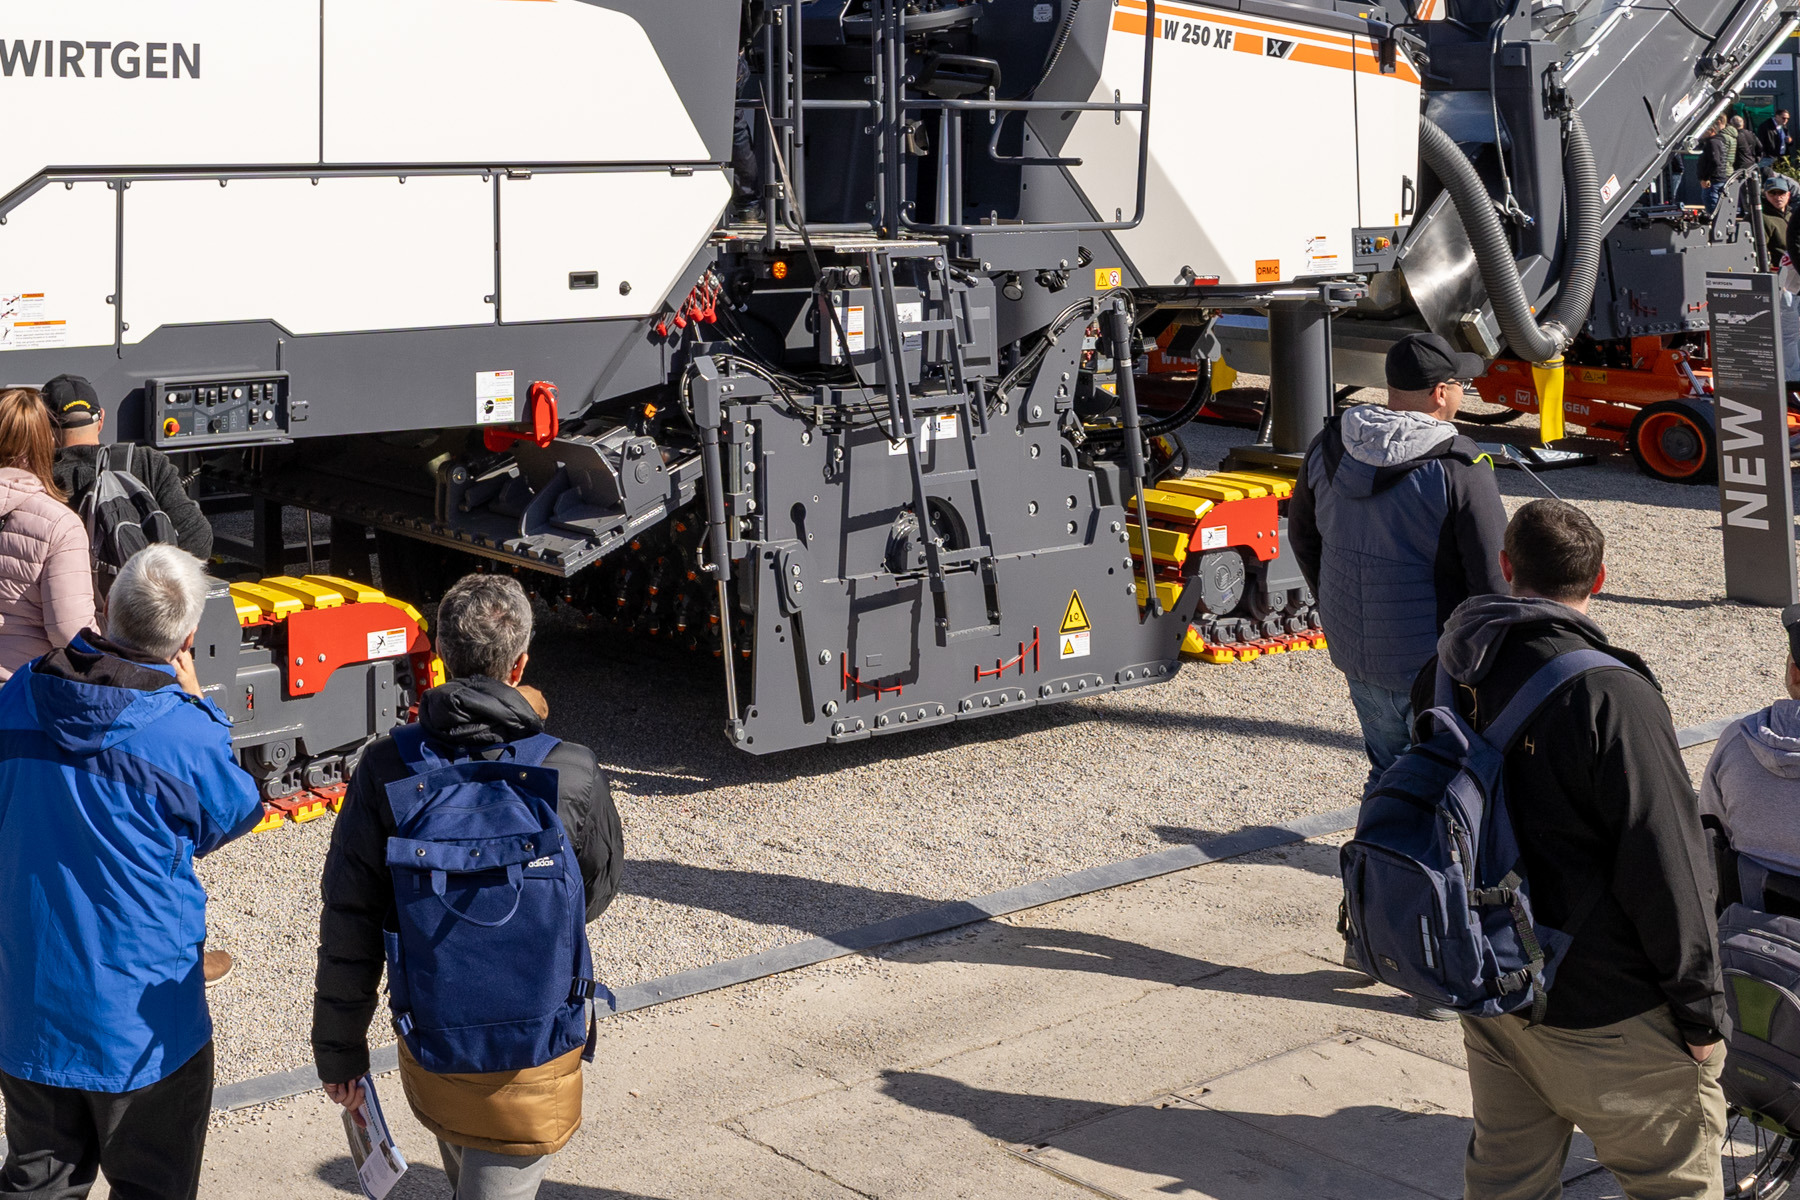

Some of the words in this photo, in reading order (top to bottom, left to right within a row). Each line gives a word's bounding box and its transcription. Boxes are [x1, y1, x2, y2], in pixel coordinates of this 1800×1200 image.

[1164, 20, 1179, 41] W
[1181, 23, 1210, 46] 250
[1213, 28, 1232, 50] XF
[1746, 79, 1777, 89] TION
[1256, 265, 1280, 276] ORM-C
[1719, 396, 1769, 531] NEW
[528, 859, 554, 868] adidas
